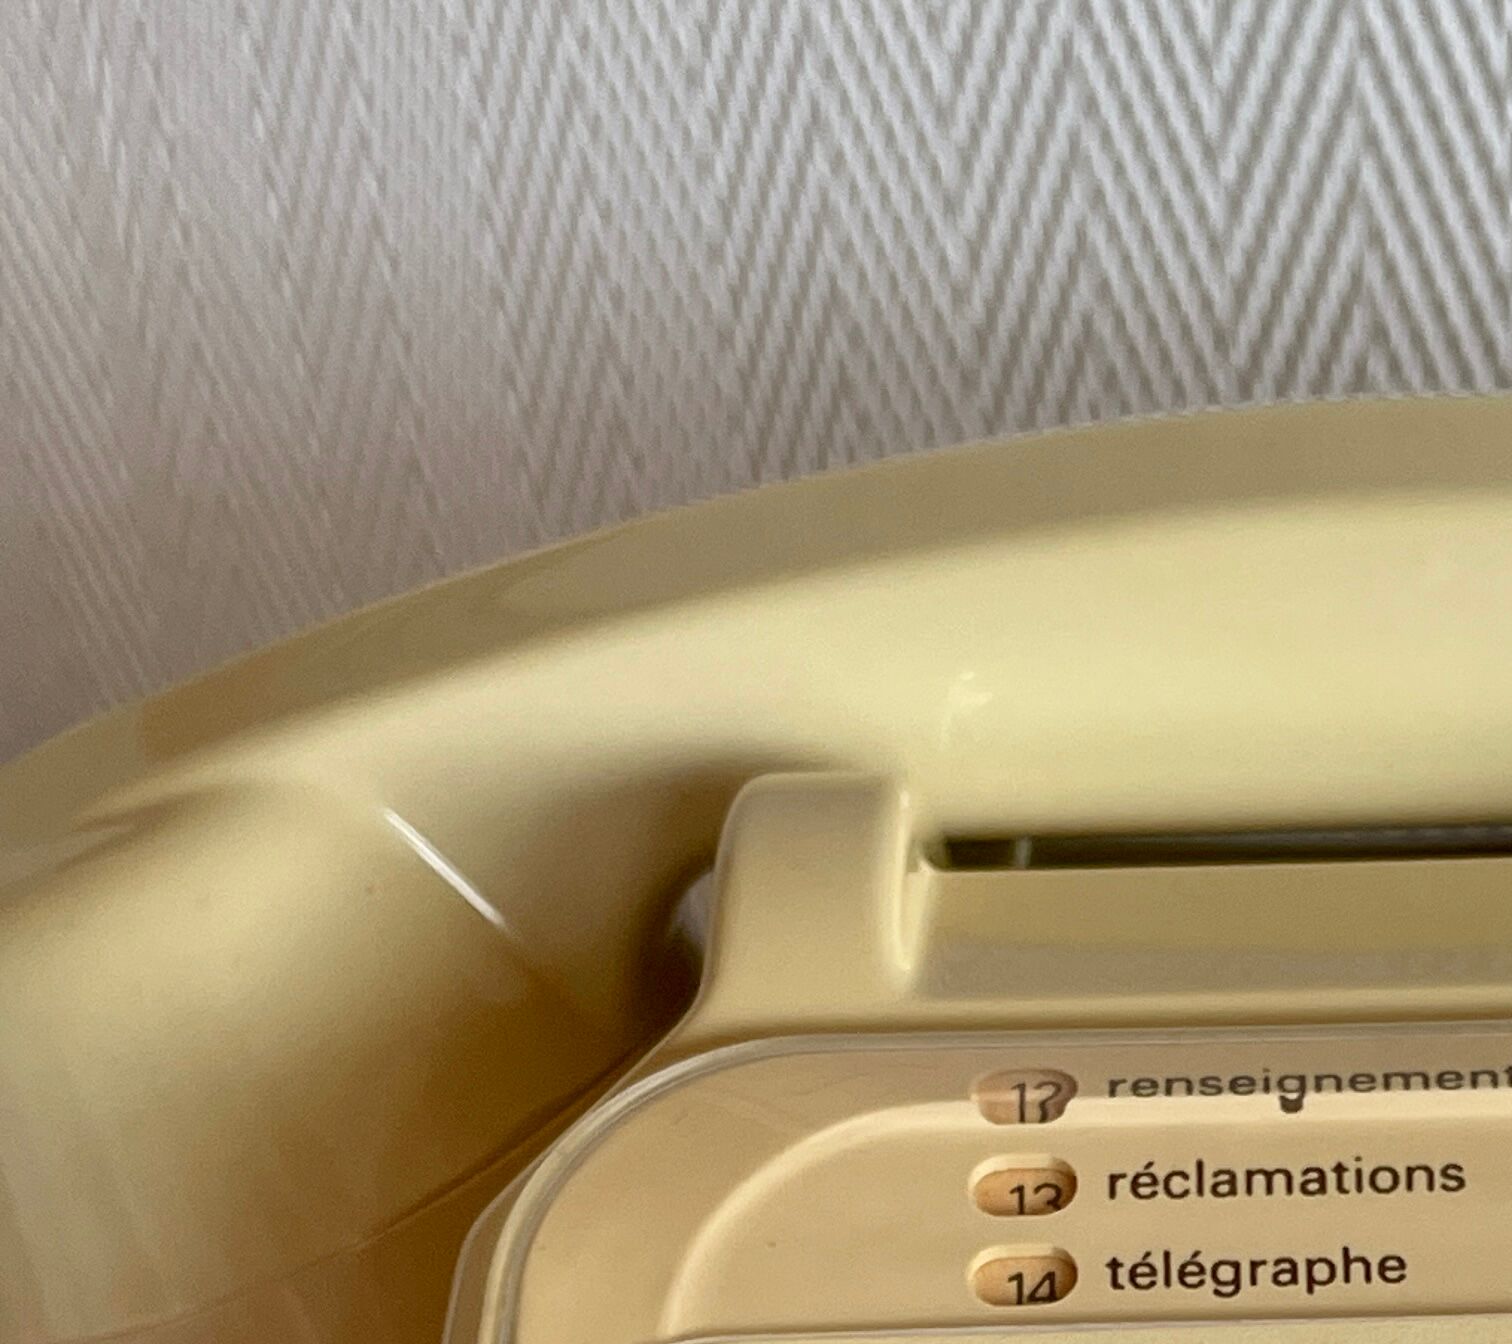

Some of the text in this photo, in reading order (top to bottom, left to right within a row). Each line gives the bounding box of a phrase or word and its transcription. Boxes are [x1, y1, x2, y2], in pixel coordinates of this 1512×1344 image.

[1108, 1156, 1467, 1201] réclamations
[1007, 1245, 1407, 1305] 14 télégraphe
